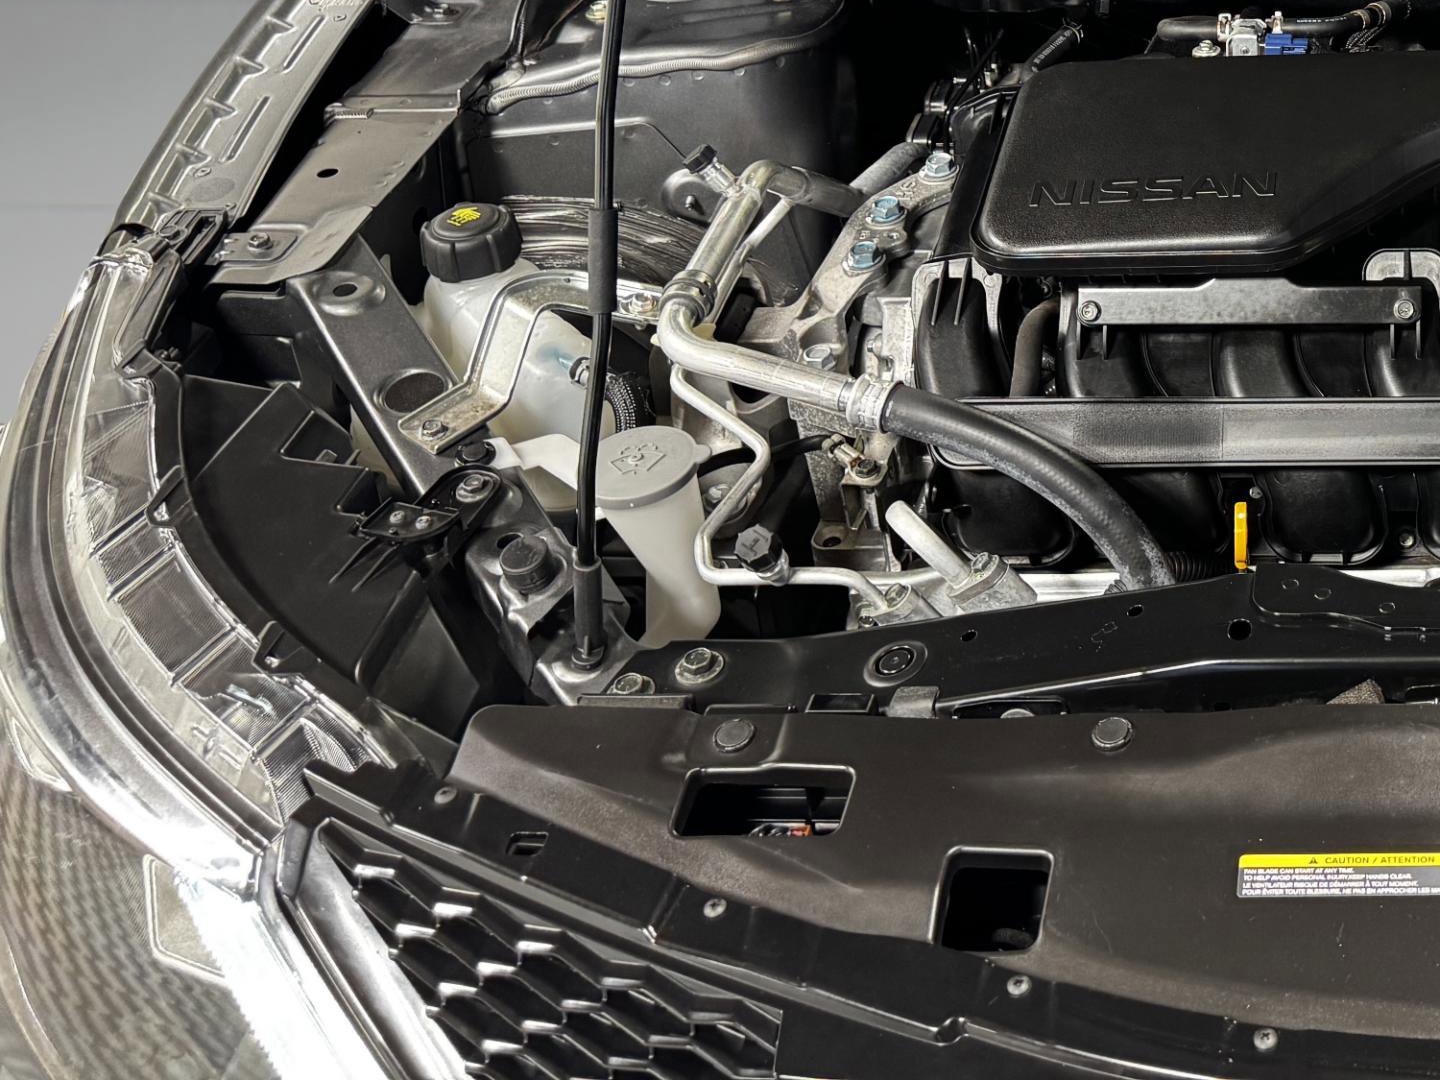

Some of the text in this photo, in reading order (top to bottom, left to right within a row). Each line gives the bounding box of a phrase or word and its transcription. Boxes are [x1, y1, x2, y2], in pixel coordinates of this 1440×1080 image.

[1028, 170, 1278, 208] NISSAN
[1324, 856, 1369, 864] CAUTION
[1381, 856, 1435, 864] ATTENTION
